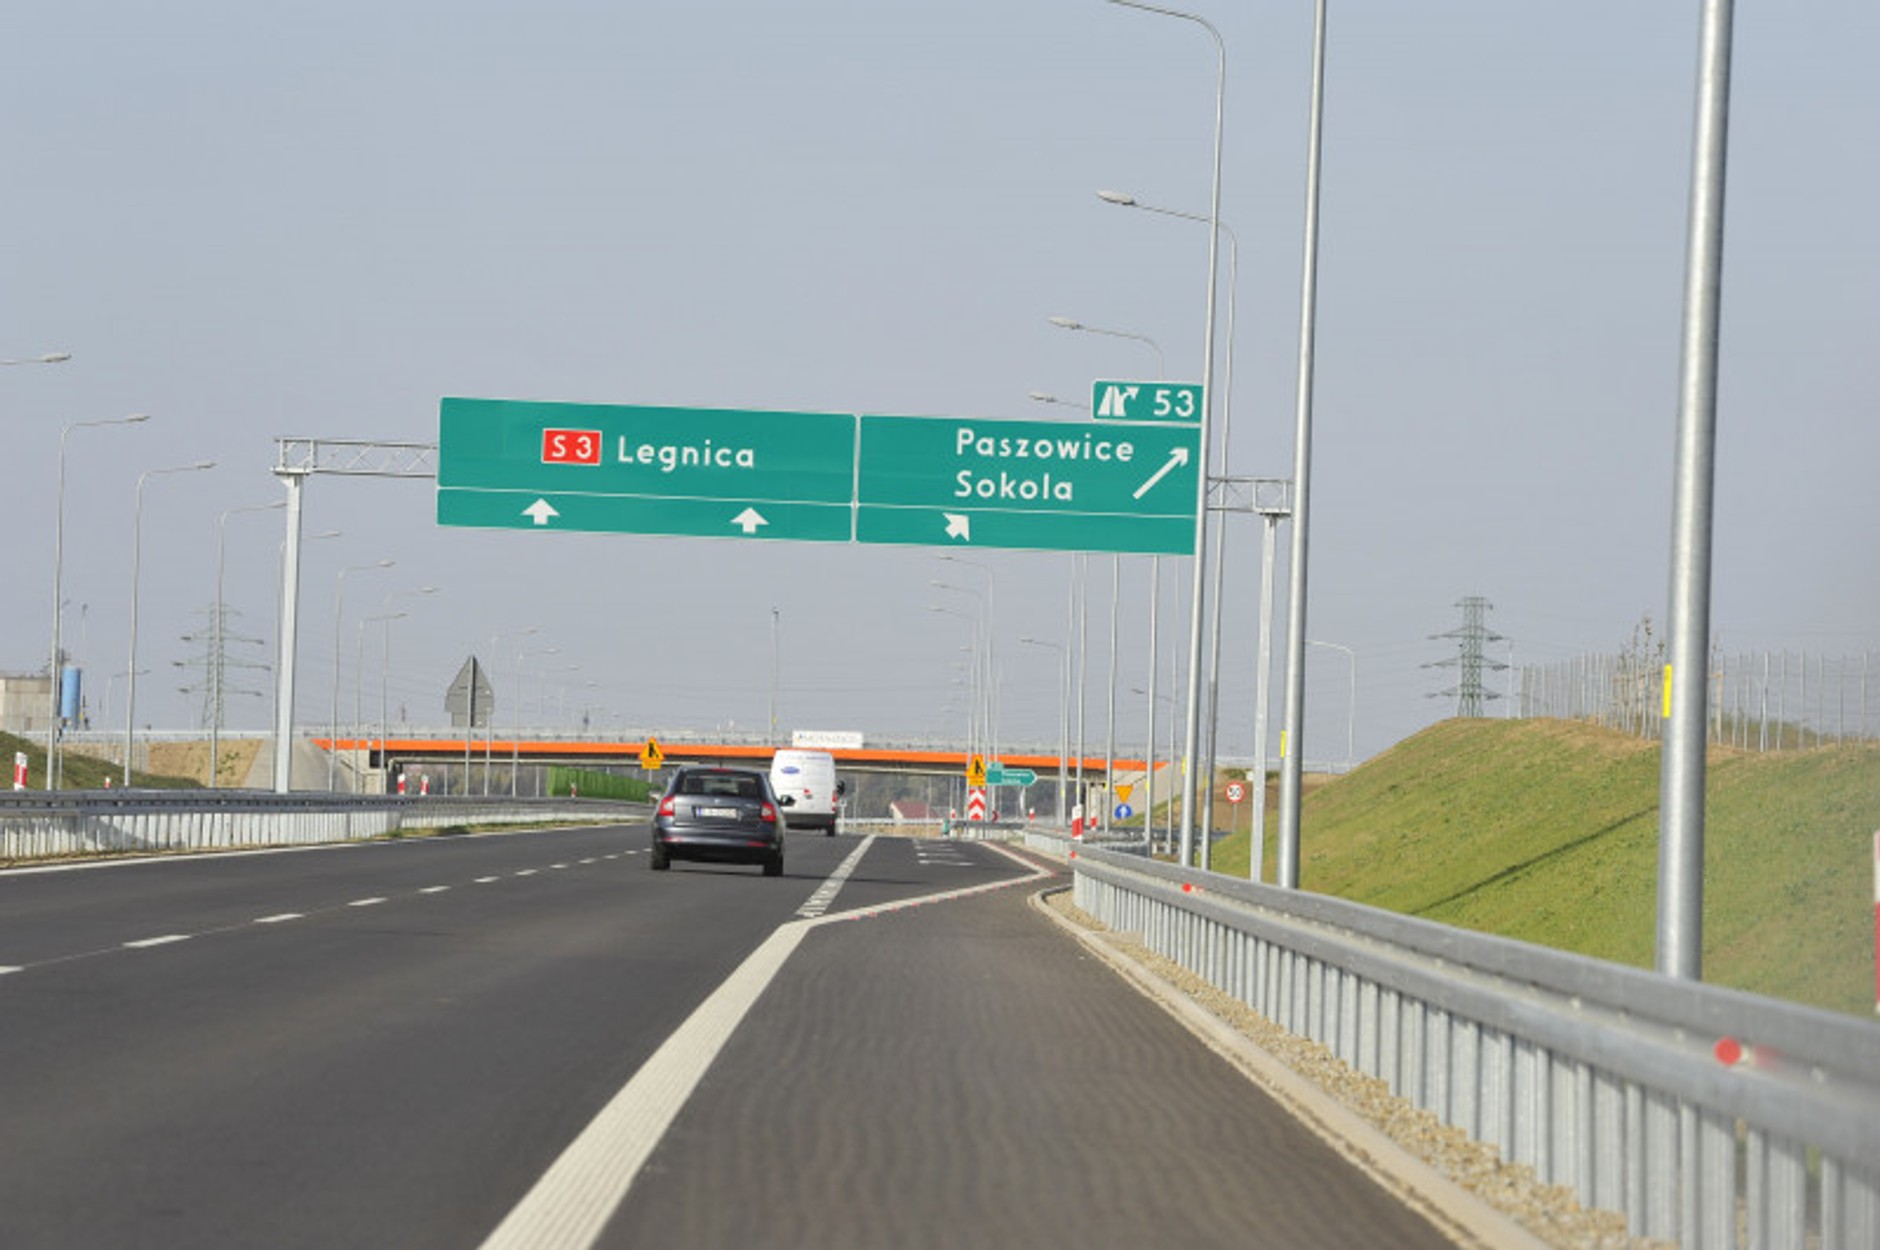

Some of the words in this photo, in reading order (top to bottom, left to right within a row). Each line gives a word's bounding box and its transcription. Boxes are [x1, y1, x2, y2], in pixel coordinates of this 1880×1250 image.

[1152, 389, 1195, 417] 53
[552, 435, 566, 459] S
[576, 436, 592, 460] 3
[618, 436, 754, 472] Legnica
[956, 428, 1133, 461] Paszowice
[955, 469, 1073, 501] Sokola
